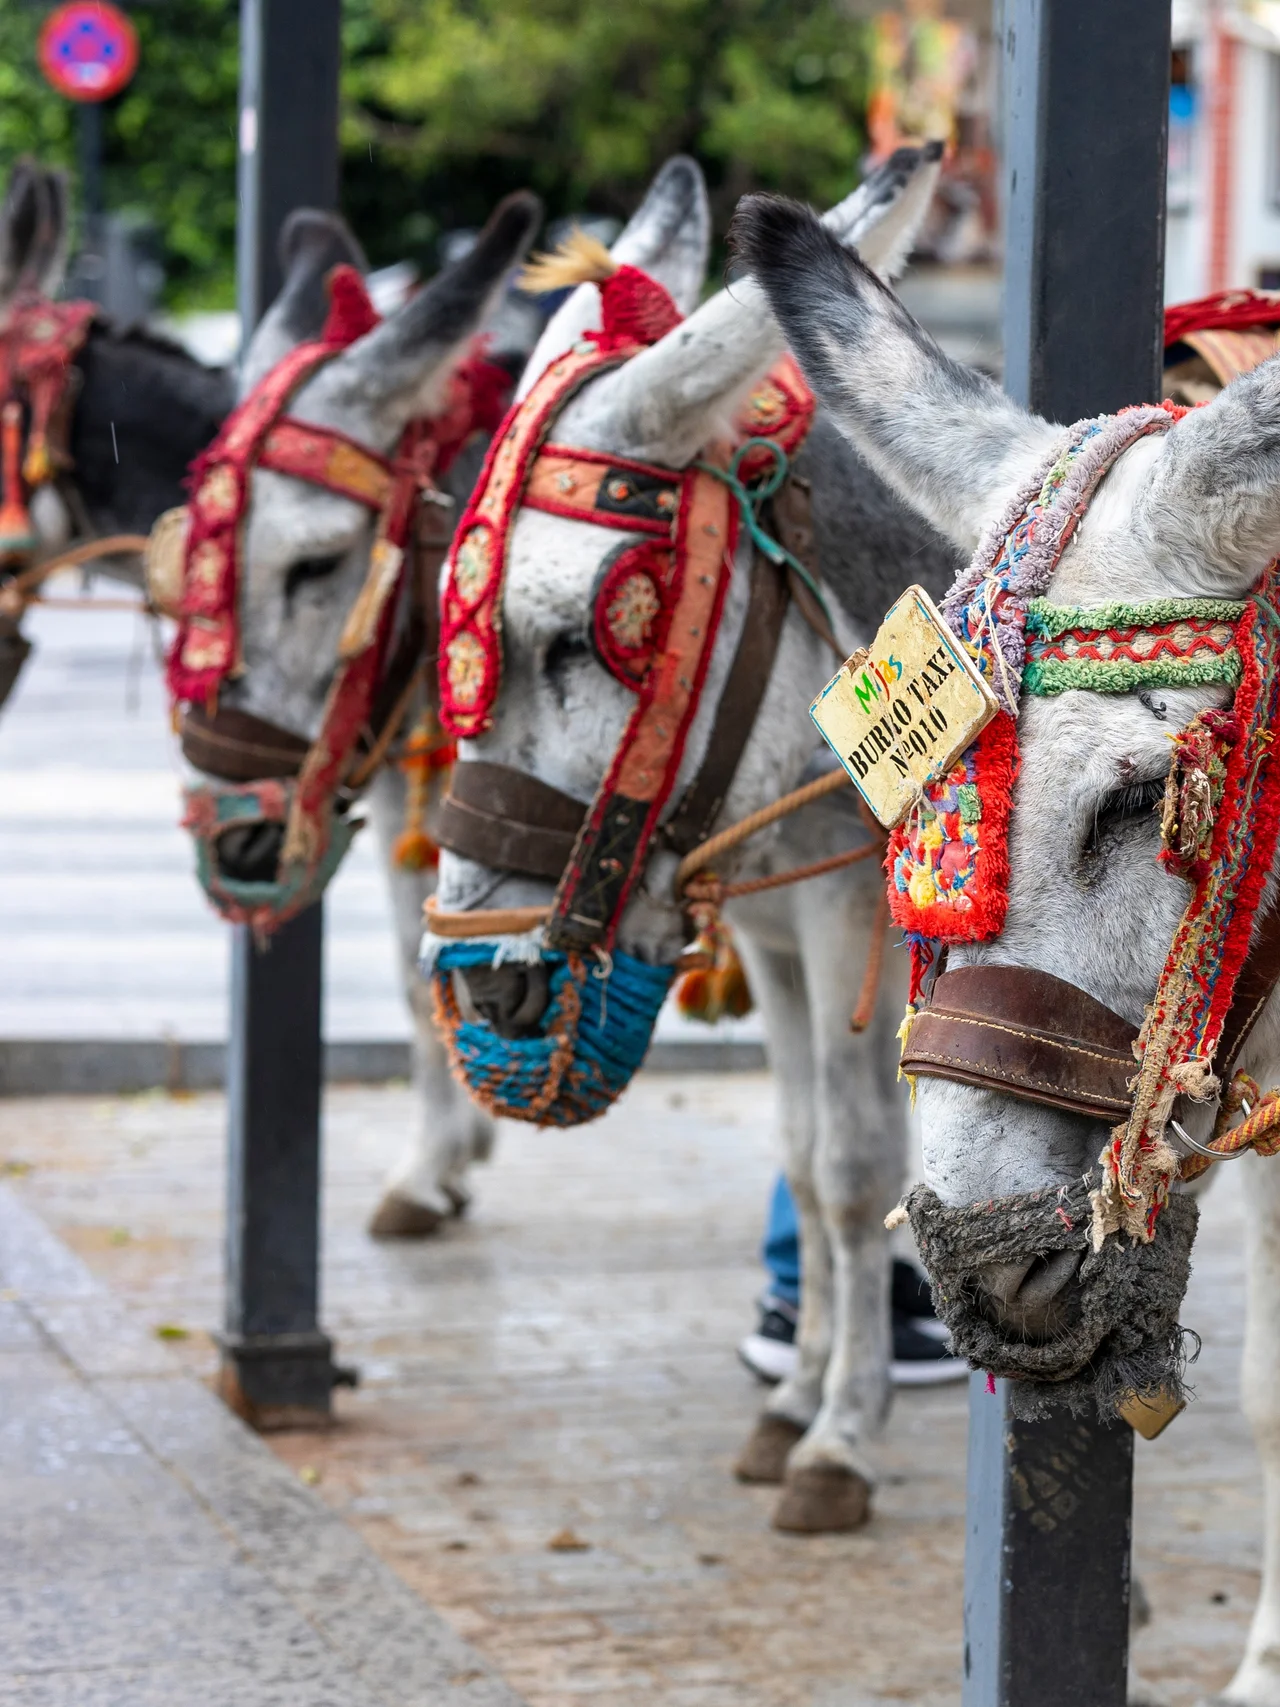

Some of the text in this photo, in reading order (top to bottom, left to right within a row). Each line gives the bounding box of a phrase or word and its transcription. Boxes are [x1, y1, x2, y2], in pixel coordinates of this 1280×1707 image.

[848, 646, 956, 780] BURRO TAXI
[854, 654, 903, 714] Mijas
